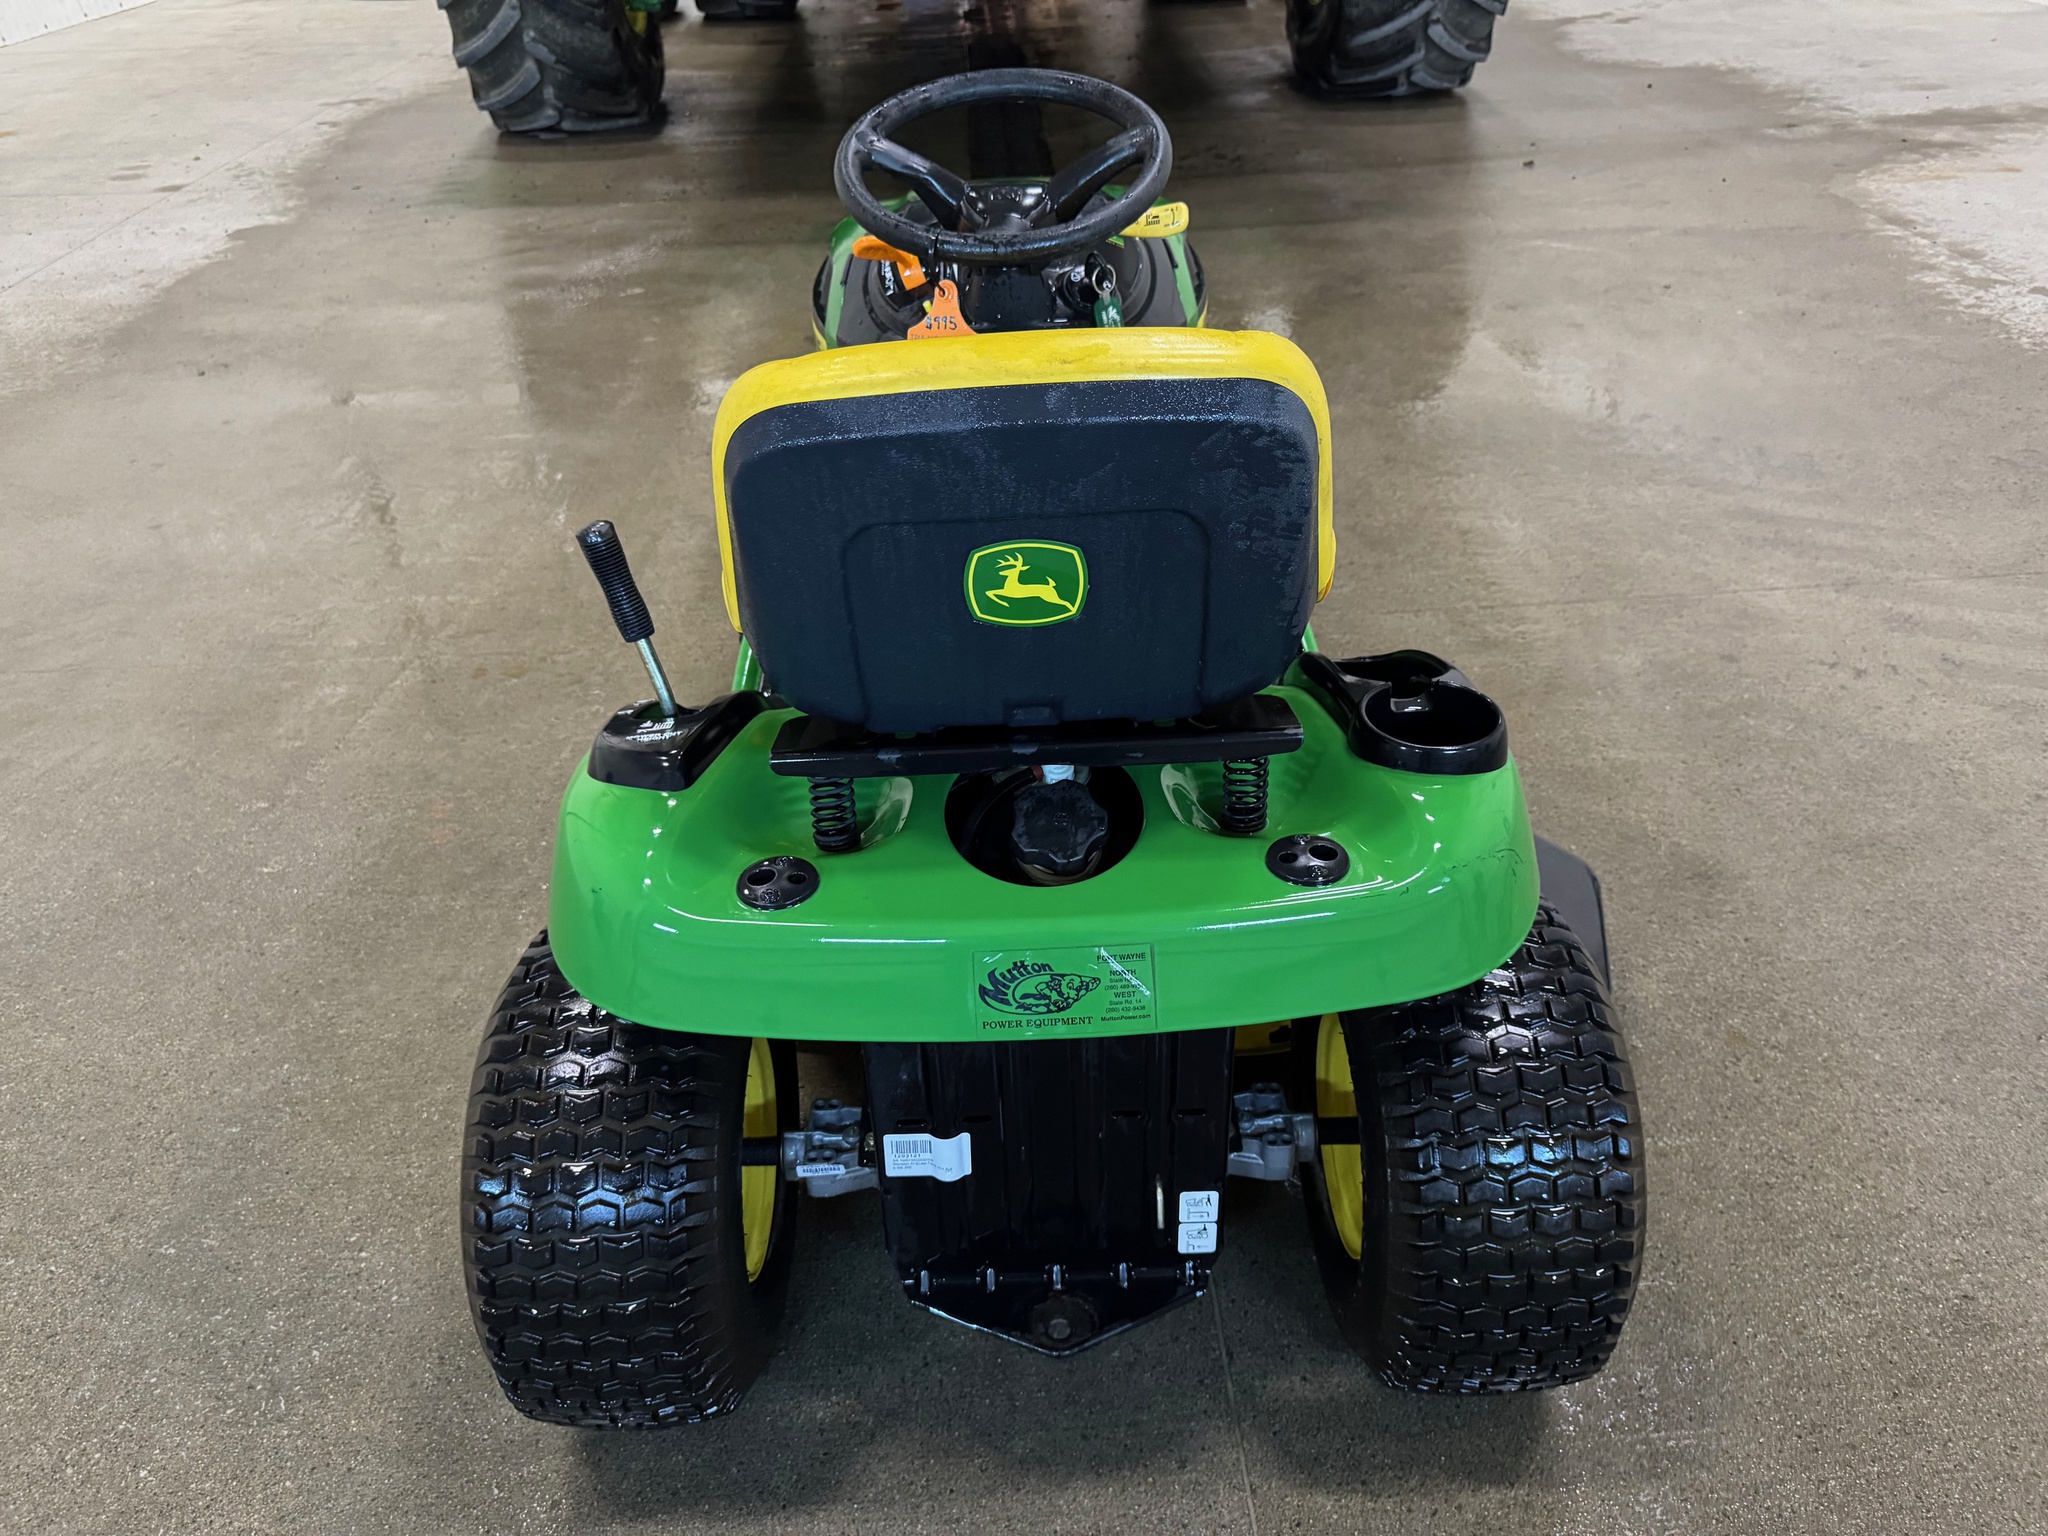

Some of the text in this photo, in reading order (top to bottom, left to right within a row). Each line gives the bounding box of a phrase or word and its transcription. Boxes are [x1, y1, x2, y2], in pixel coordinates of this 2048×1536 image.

[1118, 952, 1147, 961] WAYNE
[978, 960, 1055, 1008] Mutton
[1113, 990, 1137, 999] WEST
[1100, 1014, 1152, 1022] MuttonPower.com
[982, 1016, 1094, 1030] POWER EQUIPMENT
